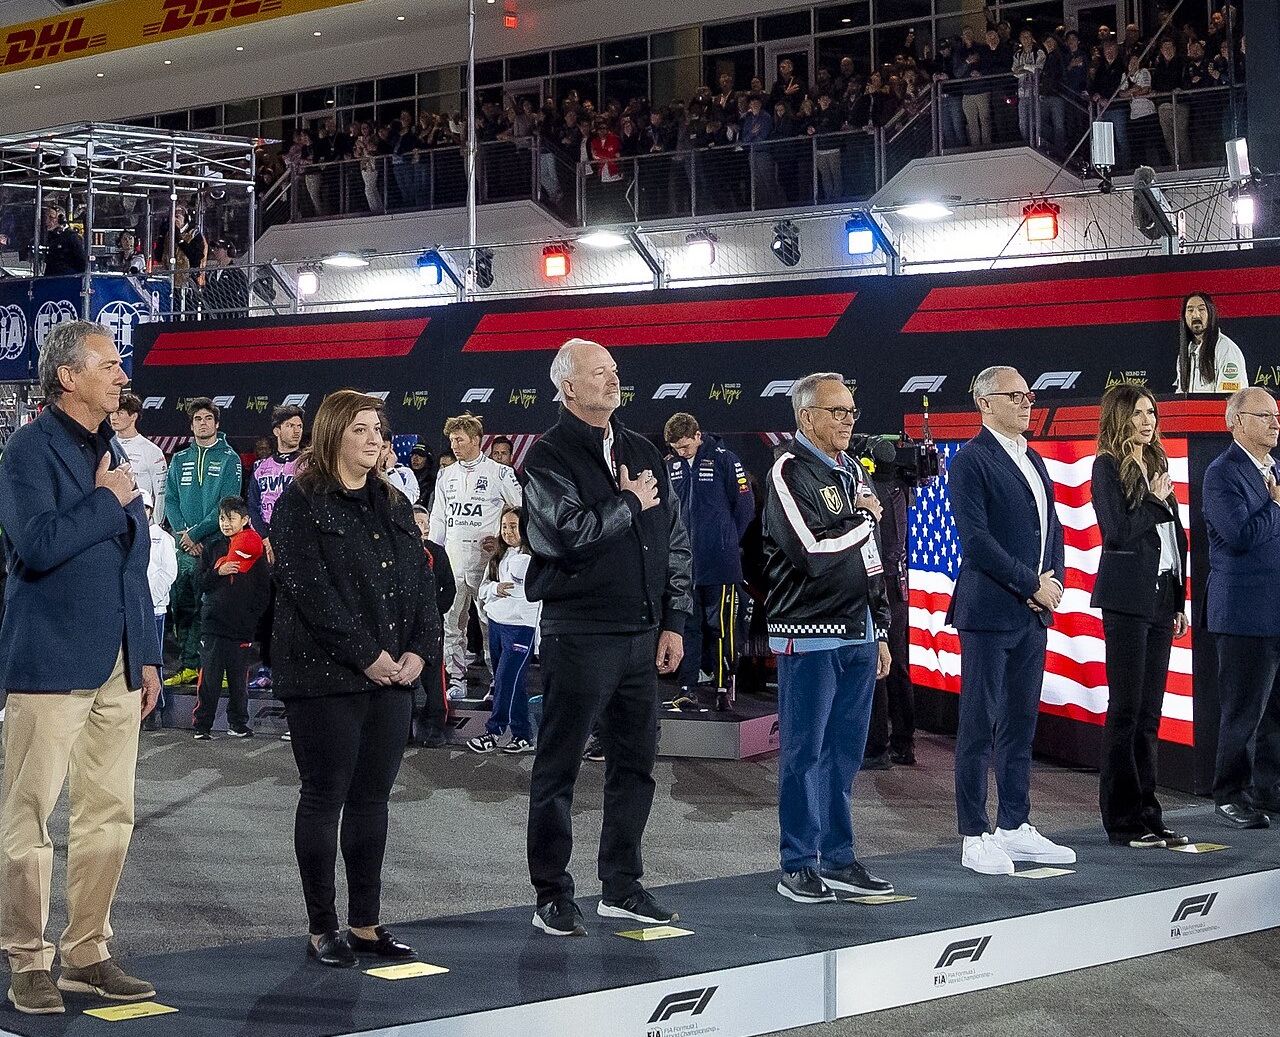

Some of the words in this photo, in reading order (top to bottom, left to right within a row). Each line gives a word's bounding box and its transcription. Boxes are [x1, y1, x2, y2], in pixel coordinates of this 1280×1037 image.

[5, 17, 91, 66] DHL
[449, 503, 483, 517] VISA
[469, 519, 482, 527] App
